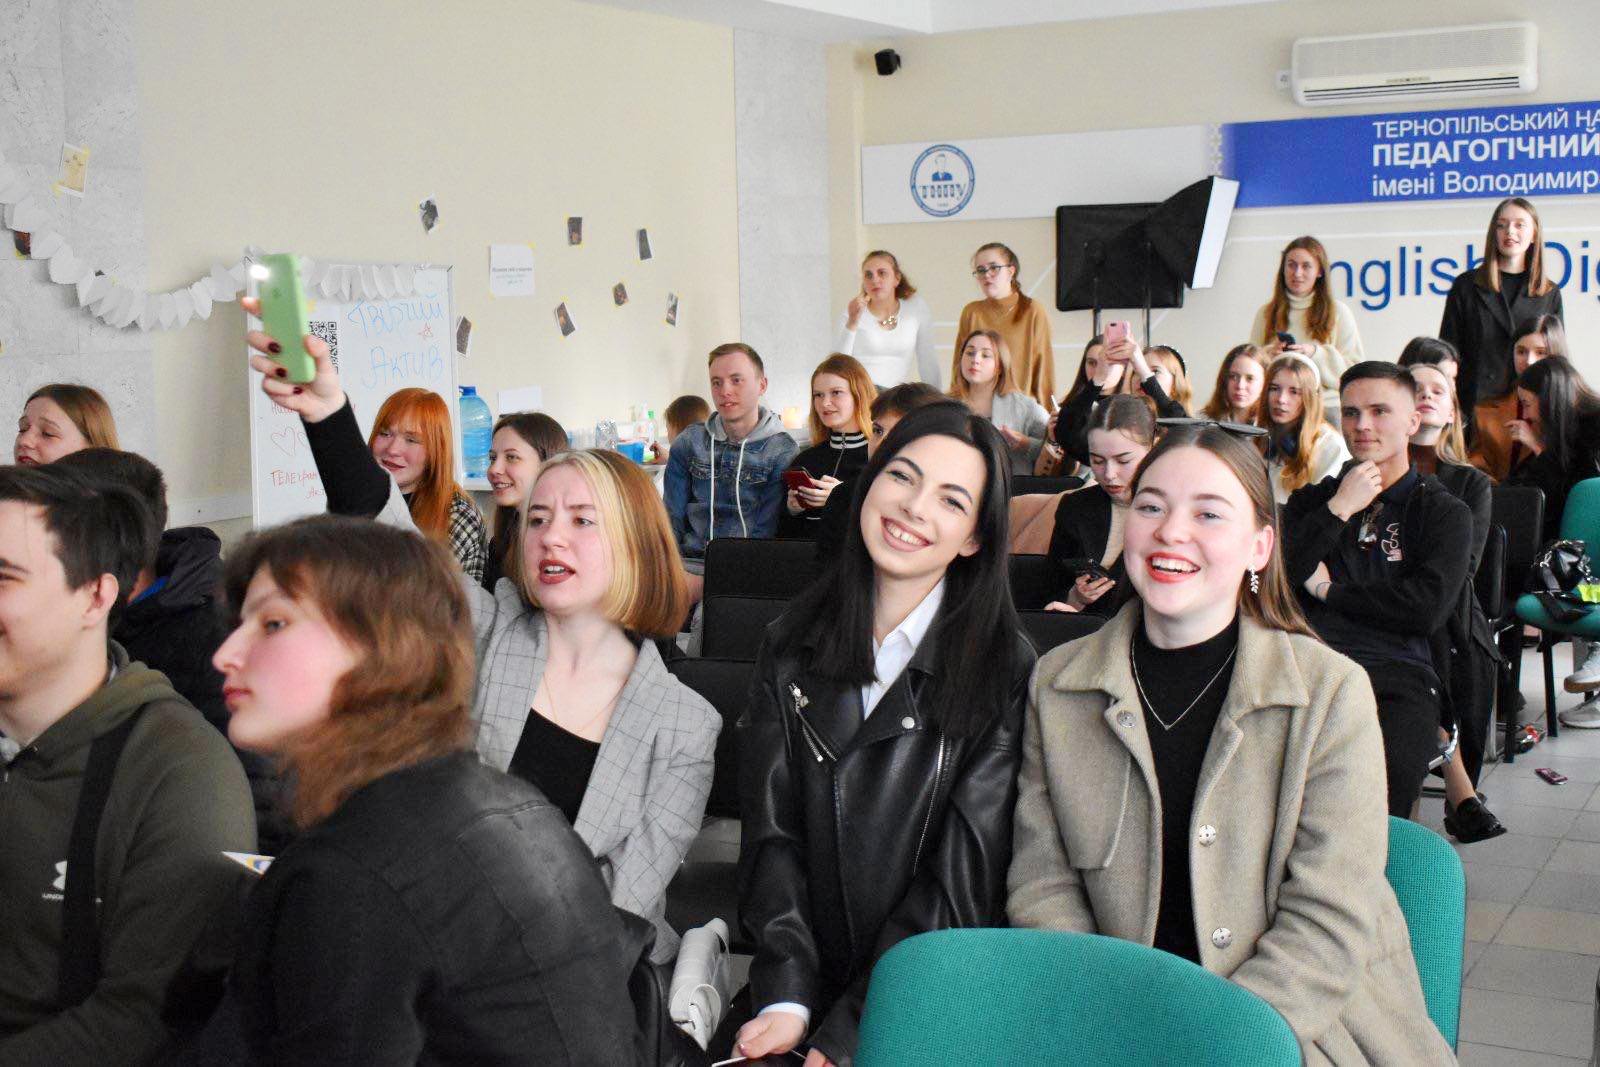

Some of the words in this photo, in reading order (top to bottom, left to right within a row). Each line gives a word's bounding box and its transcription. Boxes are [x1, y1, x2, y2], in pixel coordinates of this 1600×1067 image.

[1372, 107, 1569, 139] ТЕРНОПІЛЬСЬКИЙ
[1373, 127, 1600, 169] ПЕДАГОГІЧНИЙ
[1372, 171, 1436, 196] імені
[1443, 169, 1600, 195] Володимир
